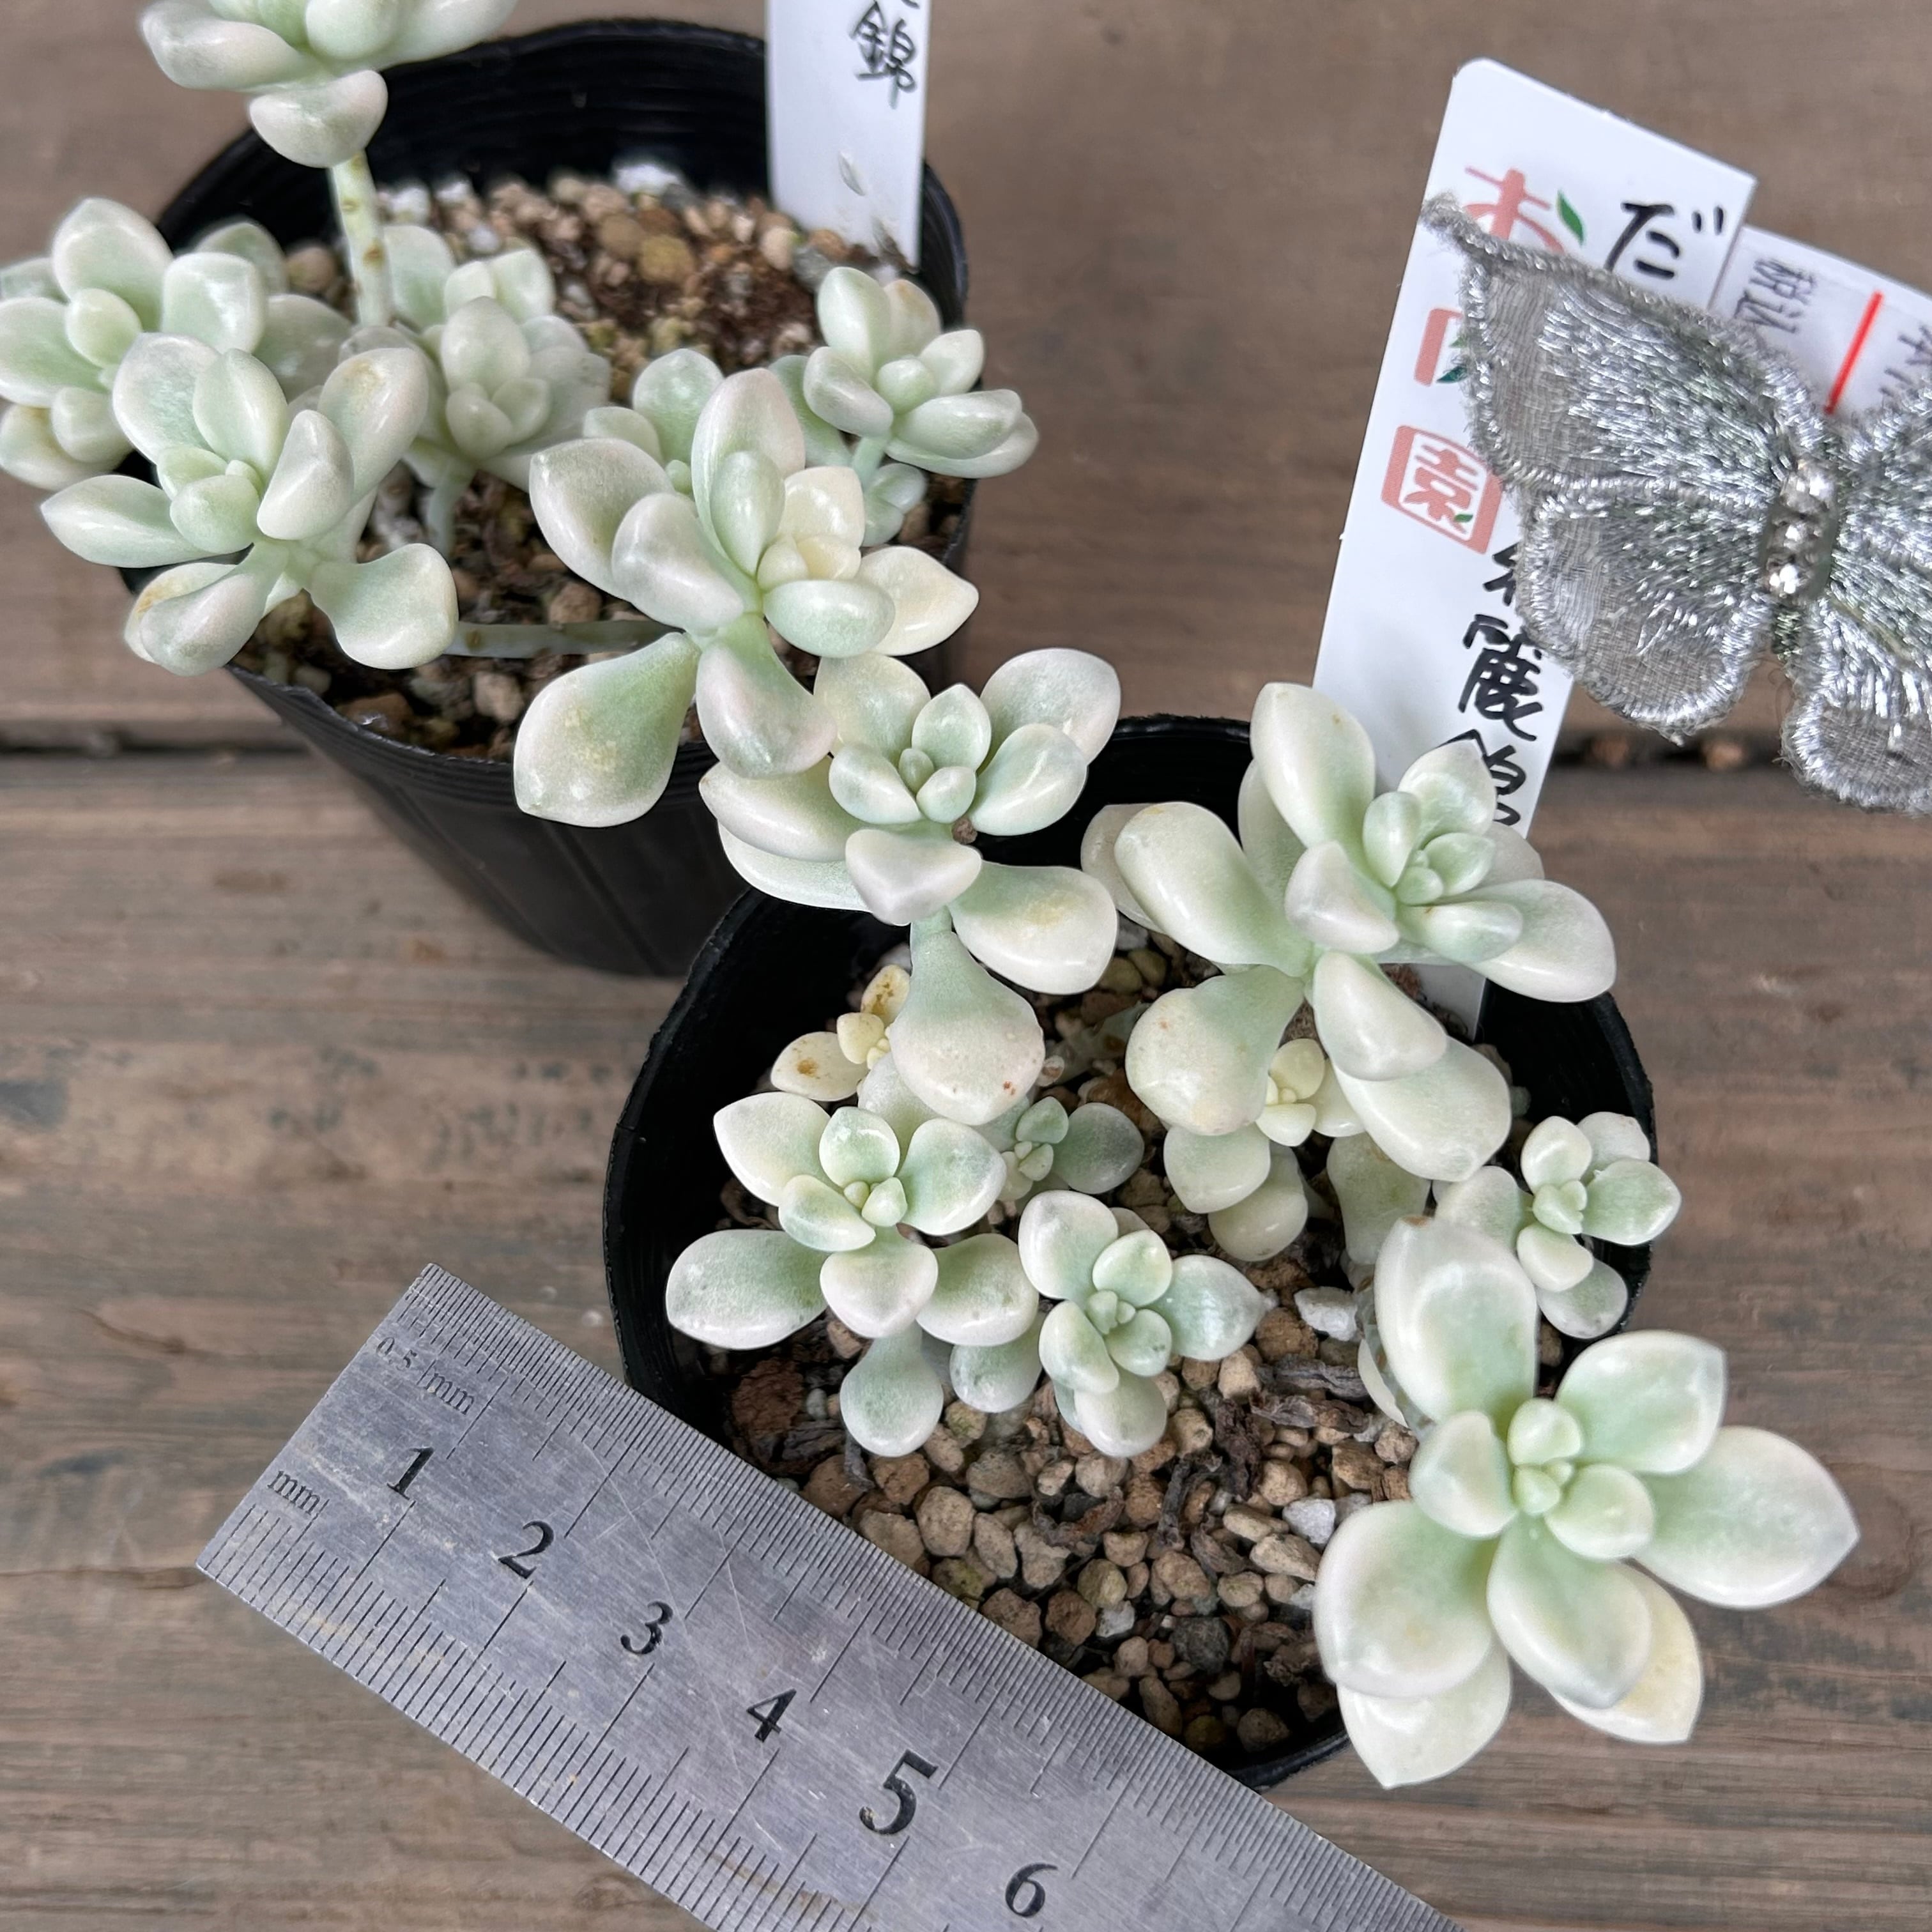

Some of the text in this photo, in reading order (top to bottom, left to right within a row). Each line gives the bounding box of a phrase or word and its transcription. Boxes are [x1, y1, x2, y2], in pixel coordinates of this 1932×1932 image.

[848, 0, 920, 110] 錦
[266, 1469, 322, 1515] mm
[387, 1446, 1059, 1917] 1 2 3 4 5 6
